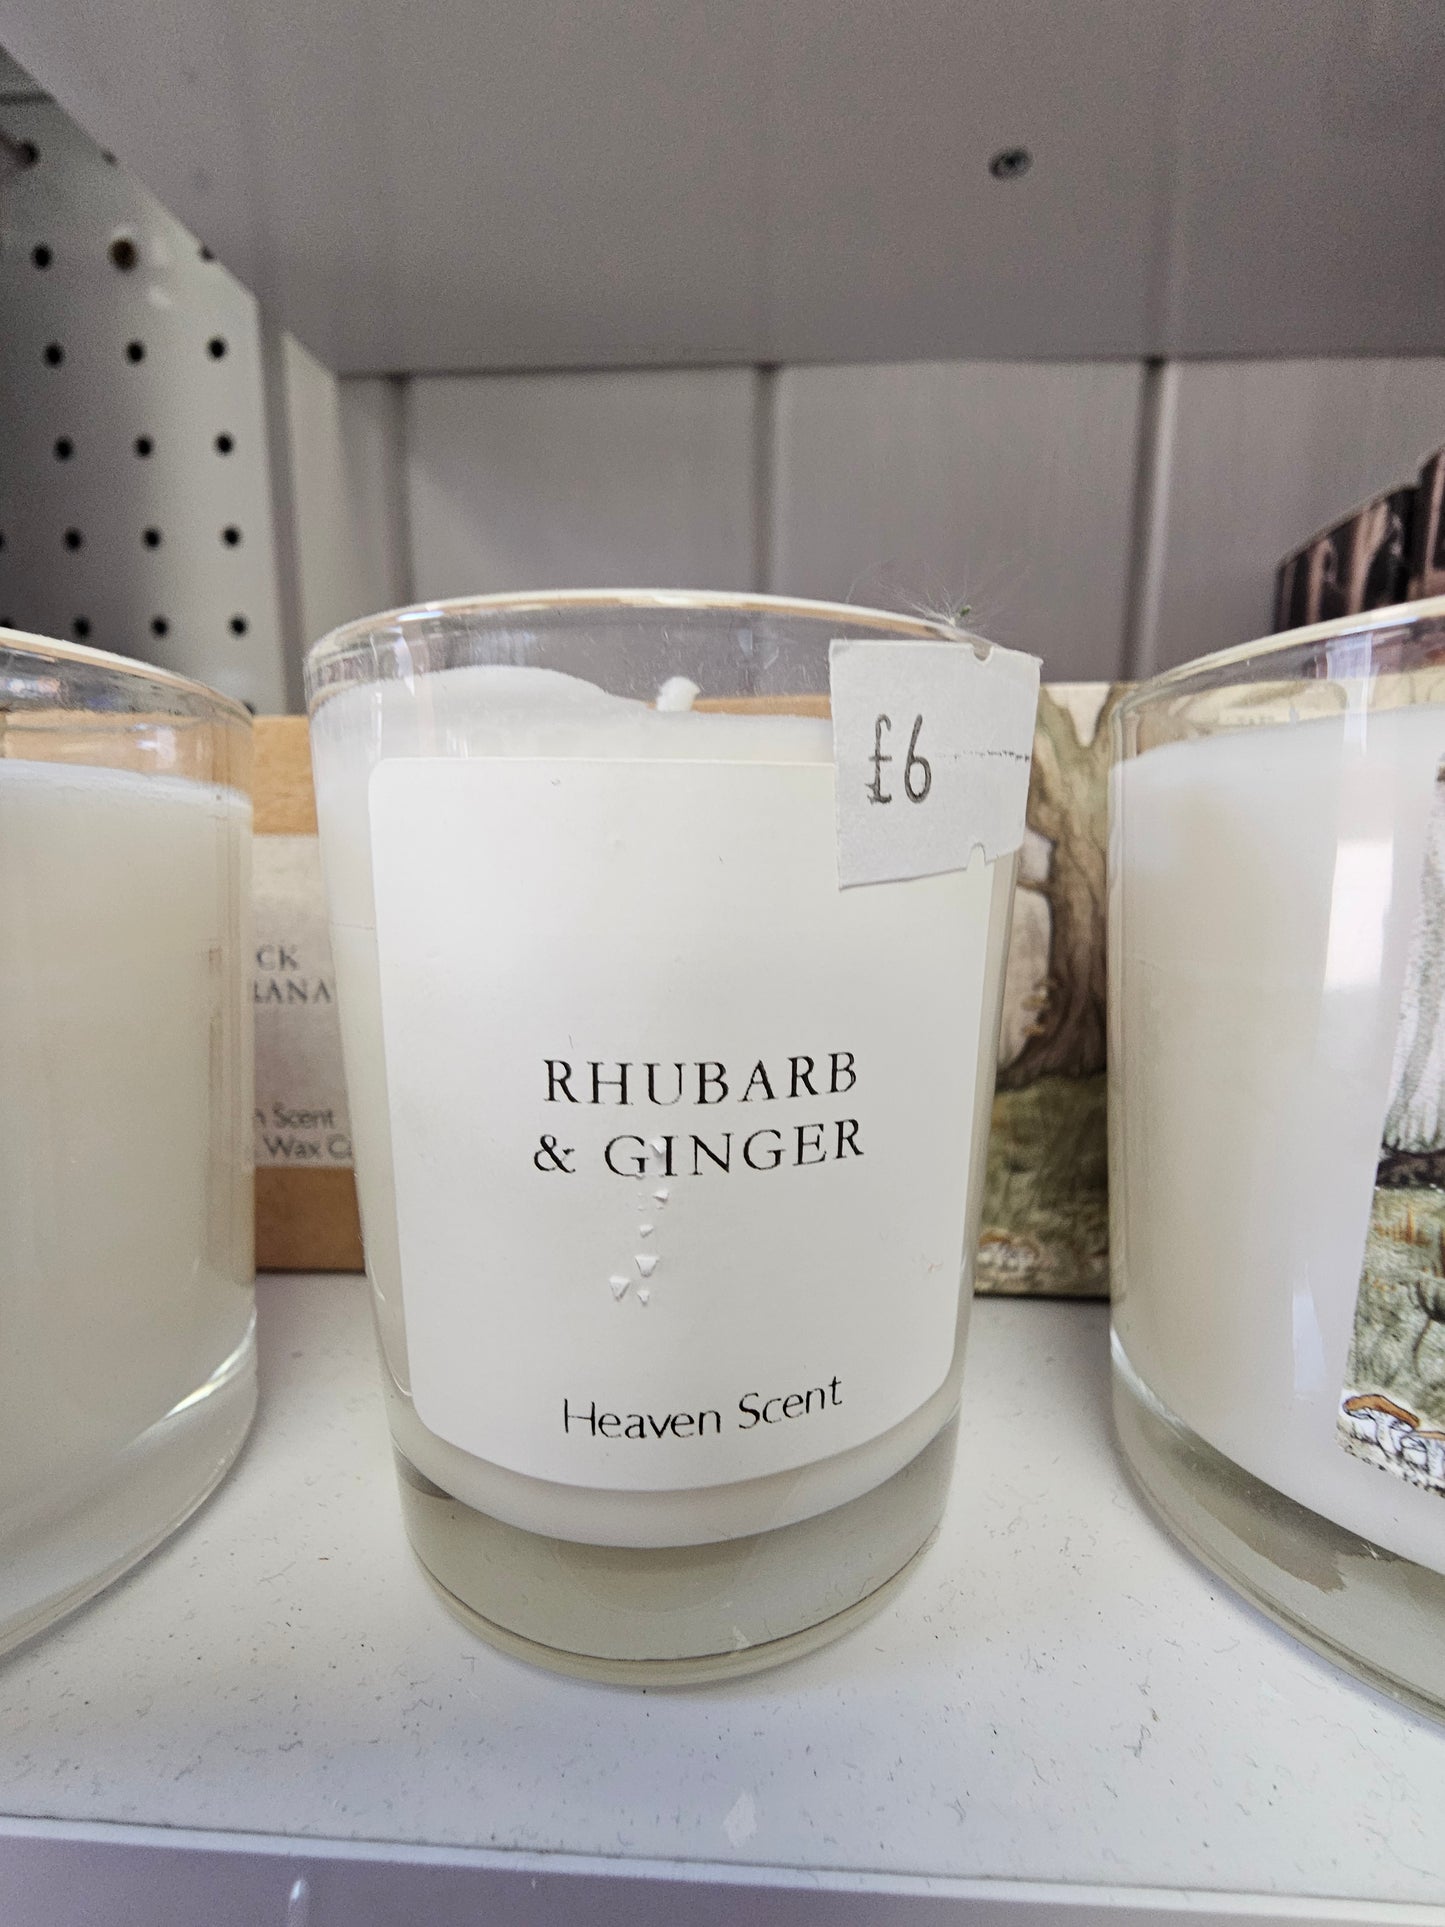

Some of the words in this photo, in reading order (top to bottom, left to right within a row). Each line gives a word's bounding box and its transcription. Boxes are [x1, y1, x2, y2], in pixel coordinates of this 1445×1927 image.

[865, 714, 932, 804] £6
[543, 1051, 857, 1105] RHUBARB
[263, 1135, 320, 1158] Wax
[533, 1134, 576, 1173] &
[604, 1118, 864, 1177] GINGER
[564, 1398, 721, 1439] Heaven
[738, 1376, 842, 1429] Scent
